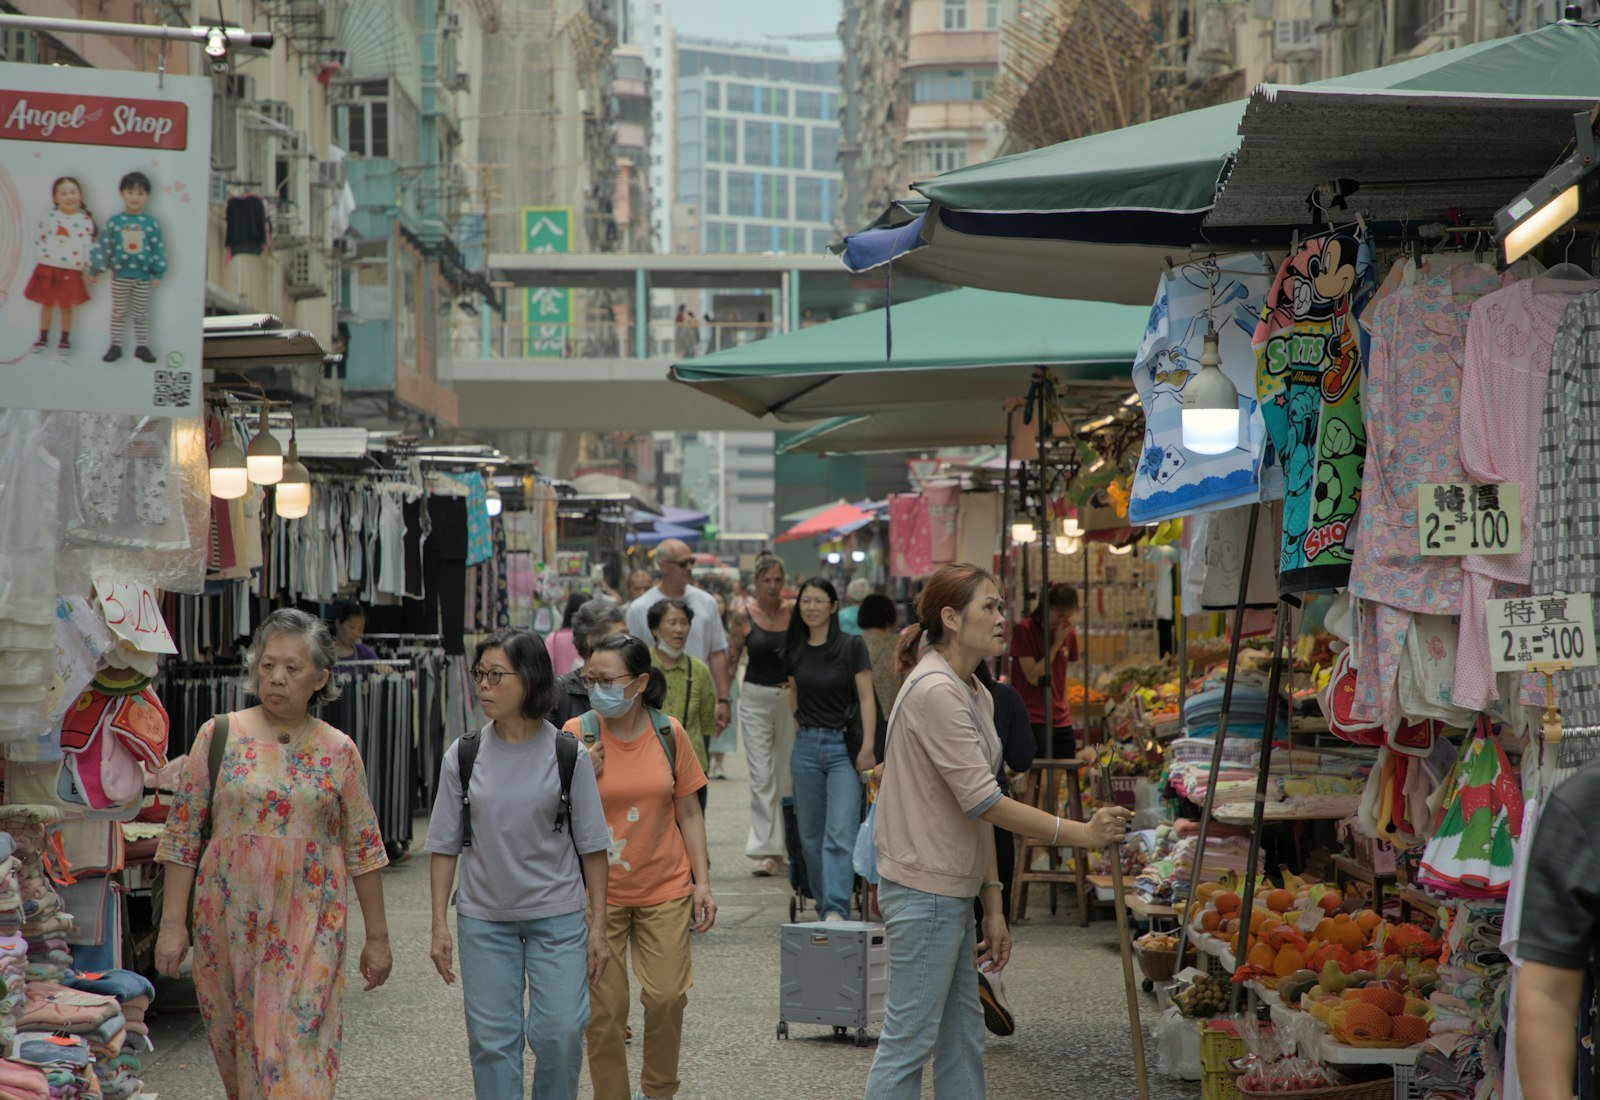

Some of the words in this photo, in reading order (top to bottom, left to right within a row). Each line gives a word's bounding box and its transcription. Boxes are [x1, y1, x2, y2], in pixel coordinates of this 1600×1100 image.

[4, 99, 87, 136] Angel
[111, 105, 173, 143] Shop
[529, 215, 566, 352] 八食品
[1433, 484, 1500, 513] 特價
[1503, 597, 1569, 625] 特賣
[1501, 630, 1516, 661] 2
[1517, 651, 1533, 662] sets
